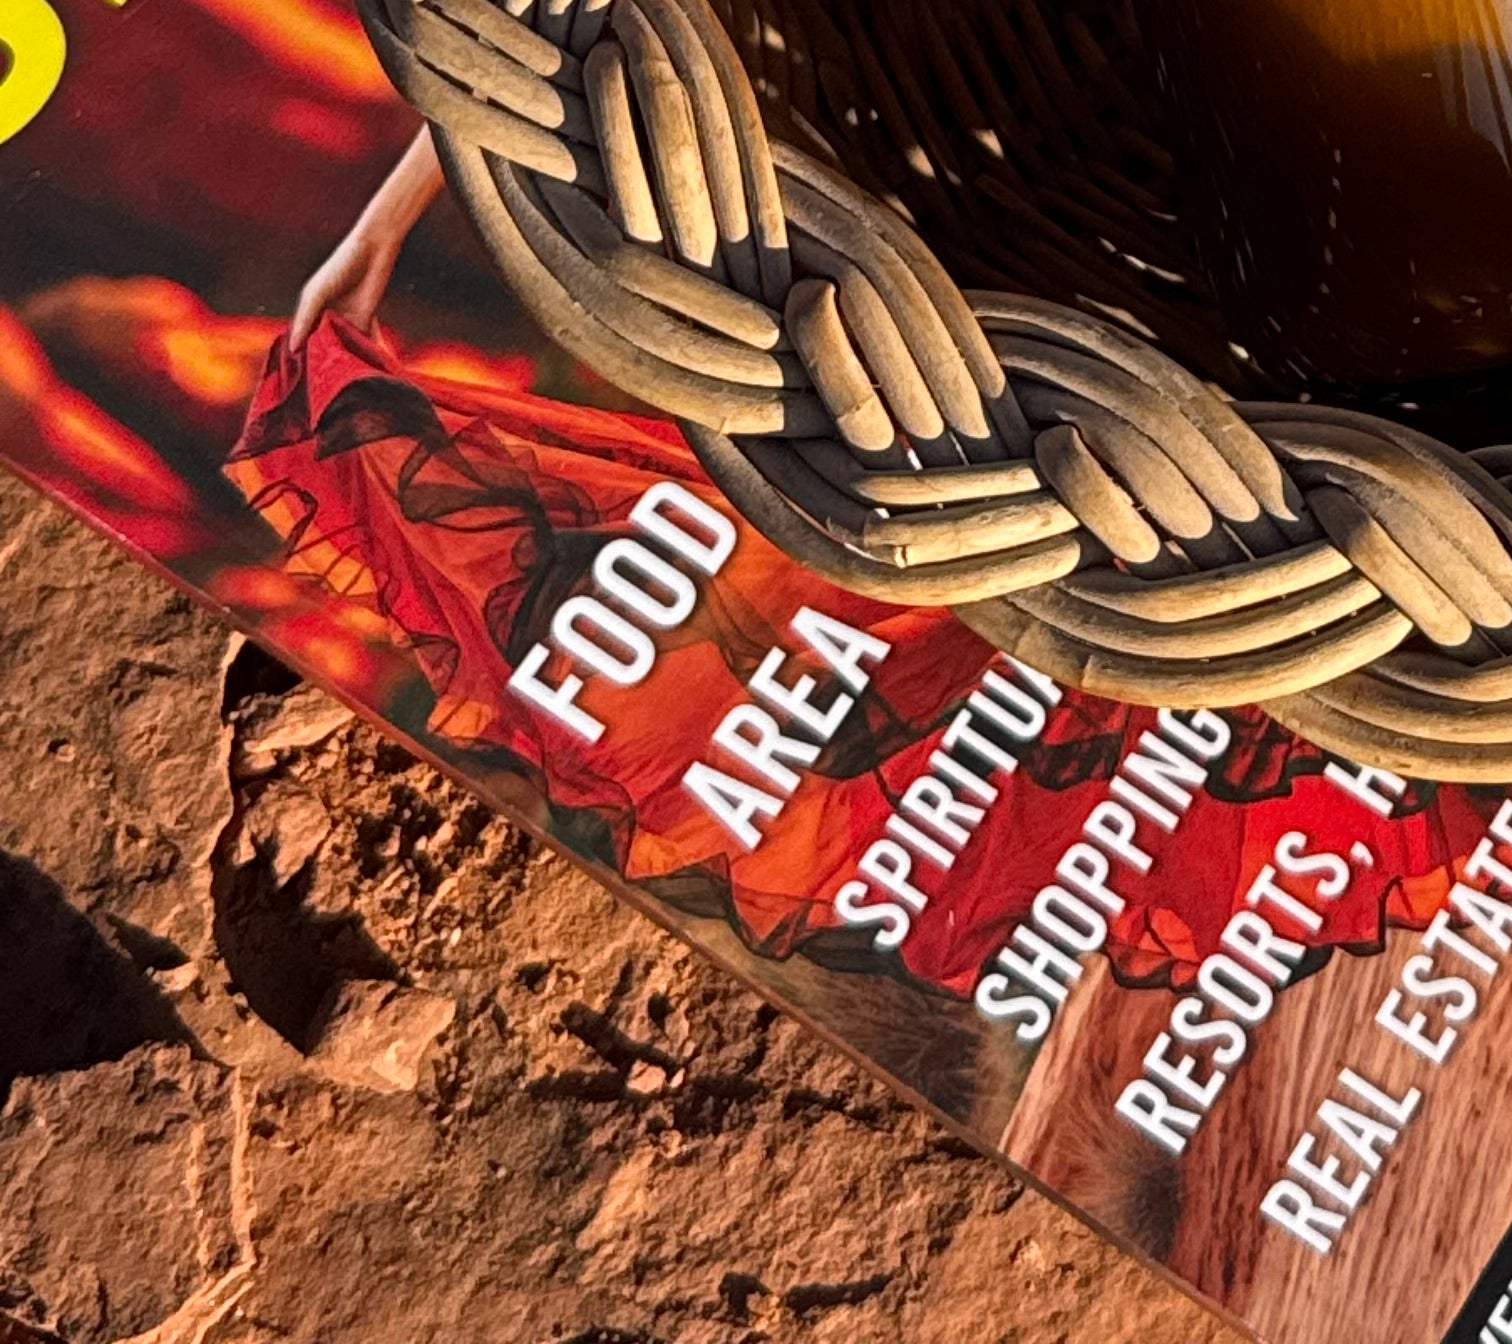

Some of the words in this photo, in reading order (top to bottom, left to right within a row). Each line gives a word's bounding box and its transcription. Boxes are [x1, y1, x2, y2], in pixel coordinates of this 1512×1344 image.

[507, 480, 738, 744] FOOD
[681, 605, 892, 852] AREA
[975, 707, 1233, 1044] SHOPPING
[1114, 829, 1375, 1158] RESORTS,
[1259, 1067, 1422, 1255] REAL
